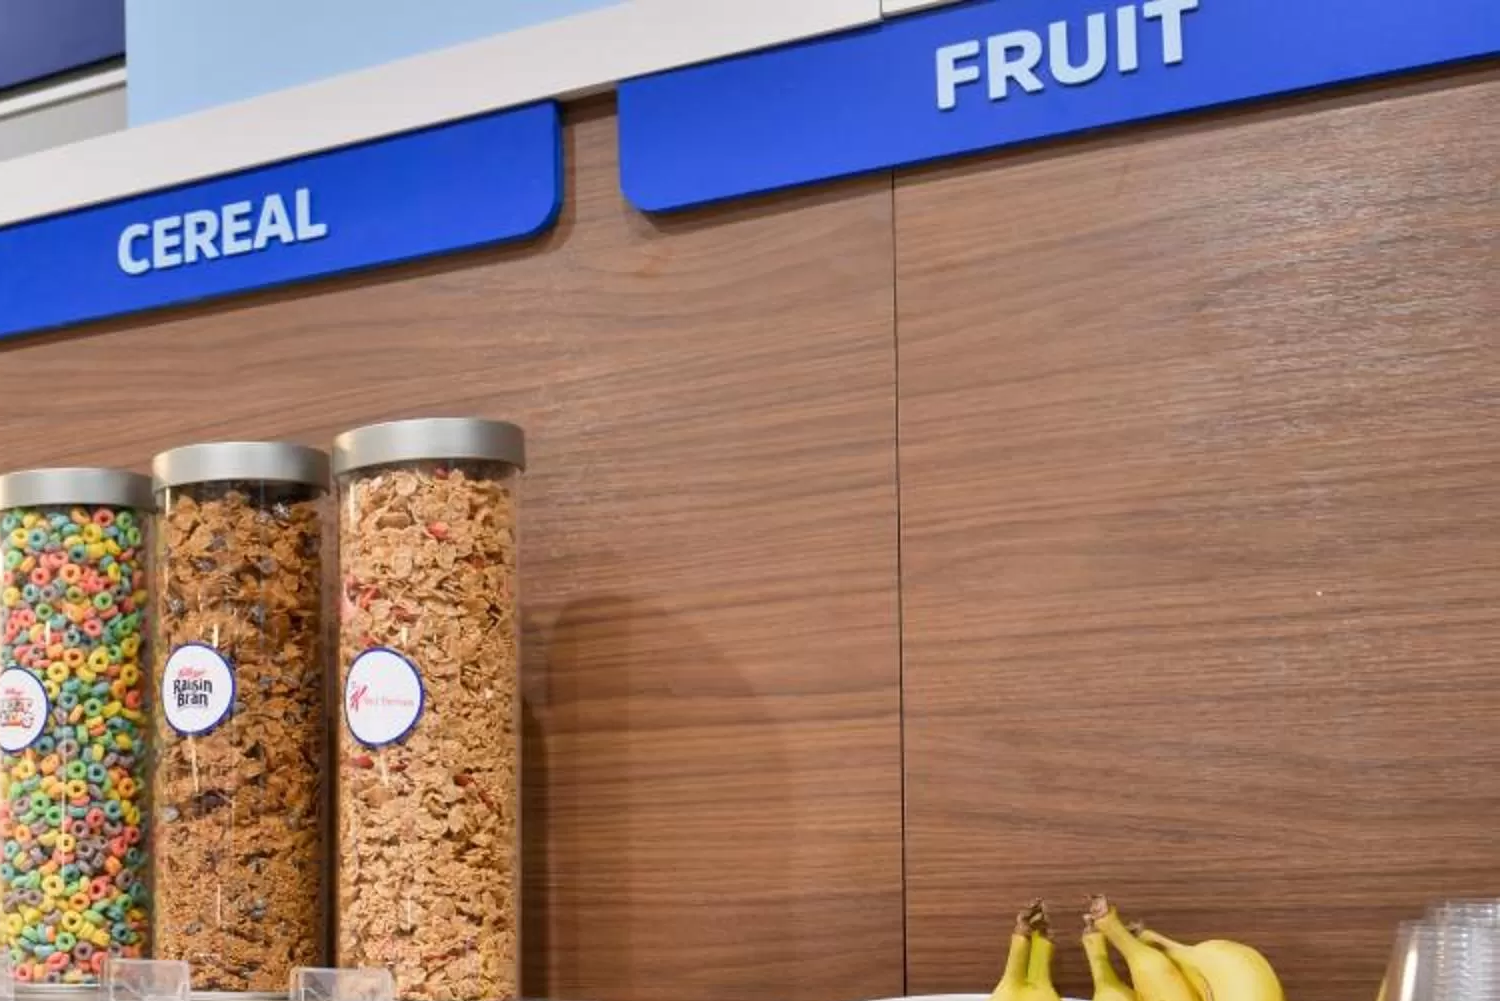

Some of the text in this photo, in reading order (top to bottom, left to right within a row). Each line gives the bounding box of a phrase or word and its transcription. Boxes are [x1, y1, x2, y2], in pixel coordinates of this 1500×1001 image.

[936, 0, 1199, 110] FRUIT
[117, 187, 328, 275] CEREAL
[173, 679, 213, 695] Raisin
[177, 693, 209, 708] Bran
